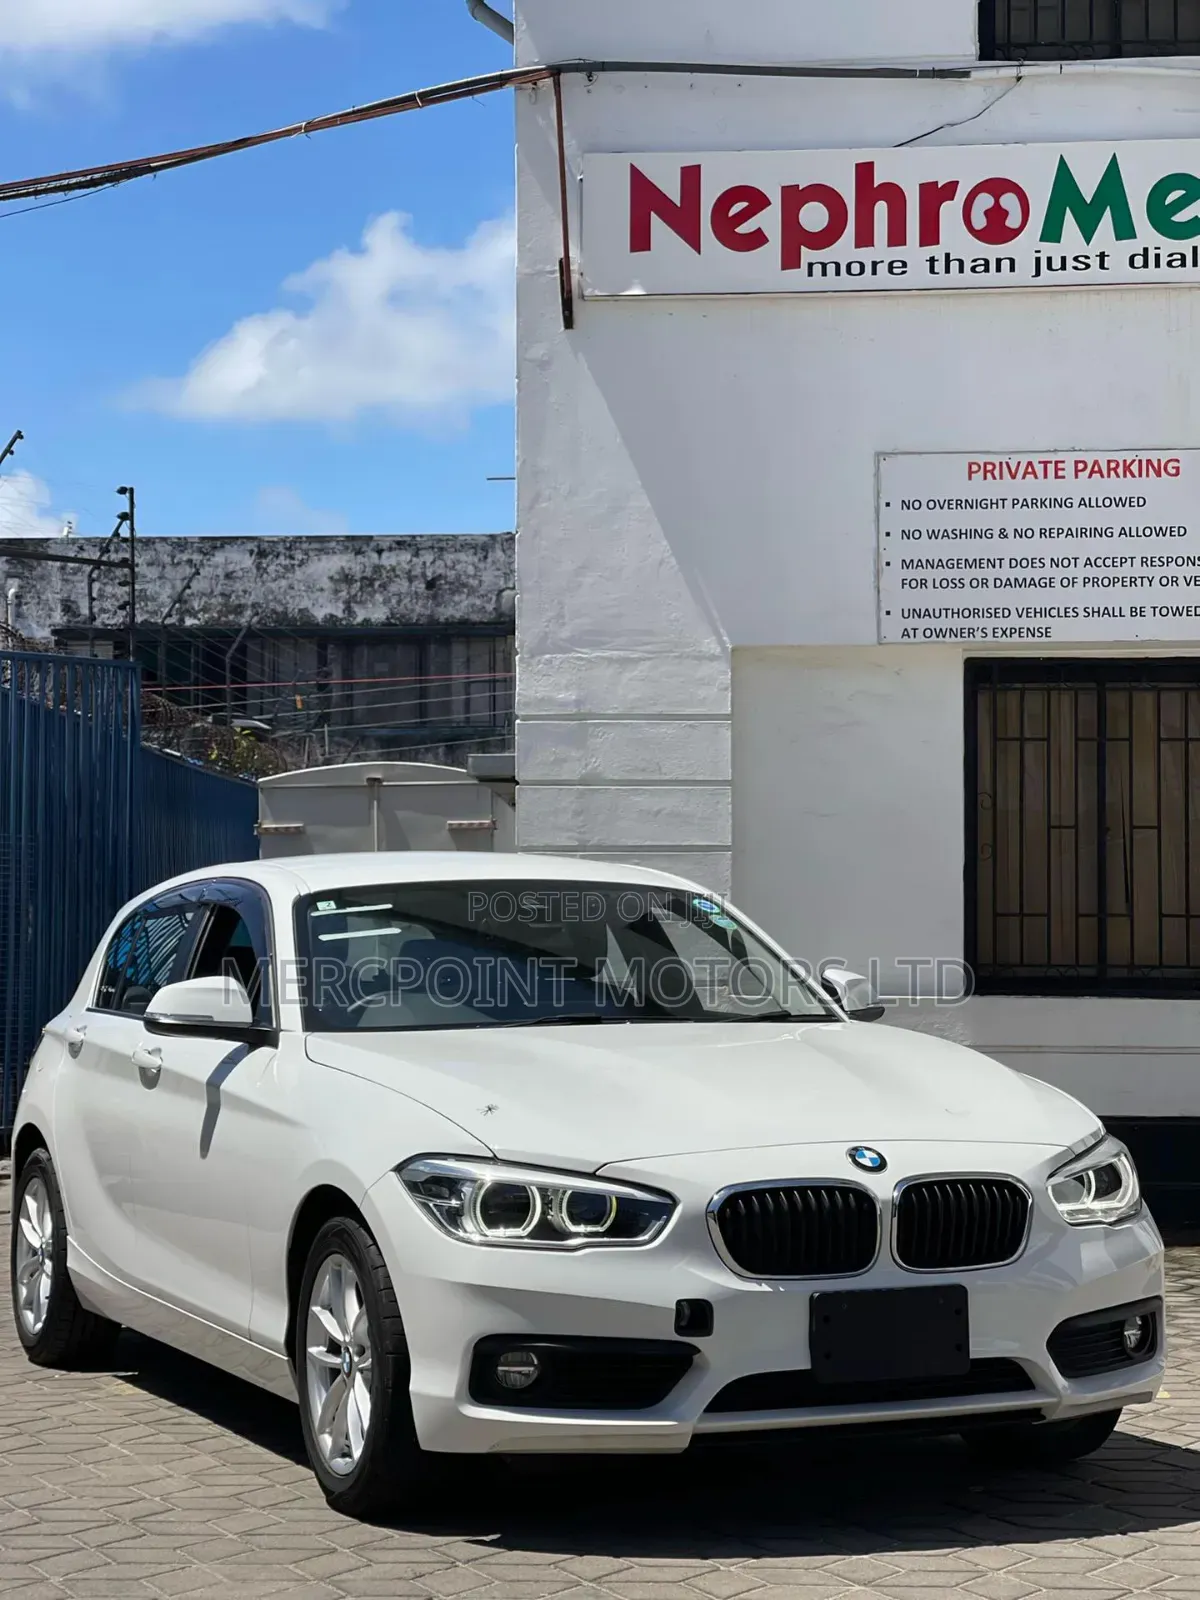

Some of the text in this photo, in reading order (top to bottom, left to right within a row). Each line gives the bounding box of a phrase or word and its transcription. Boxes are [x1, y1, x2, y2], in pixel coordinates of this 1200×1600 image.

[806, 245, 1199, 278] more than just dial
[967, 458, 1181, 481] PRIVATE PARKING
[901, 496, 1147, 511] NO OVERNIGHT PARKING ALLOWED
[901, 525, 1187, 541] NO WASHING & NO REPAIRING ALLOWED
[901, 557, 1005, 570] MANAGEMENT
[1008, 557, 1046, 569] DOES
[1050, 556, 1080, 569] NOT
[1083, 556, 1137, 569] ACCEPT
[901, 575, 1200, 590] FOR LOSS OR DAMAGE OF PROPERTY OR VE
[901, 605, 1200, 620] UNAUTHORISED VEHICLES SHALL BE TOWED
[900, 626, 1052, 639] AT OWNER’S EXPENSE
